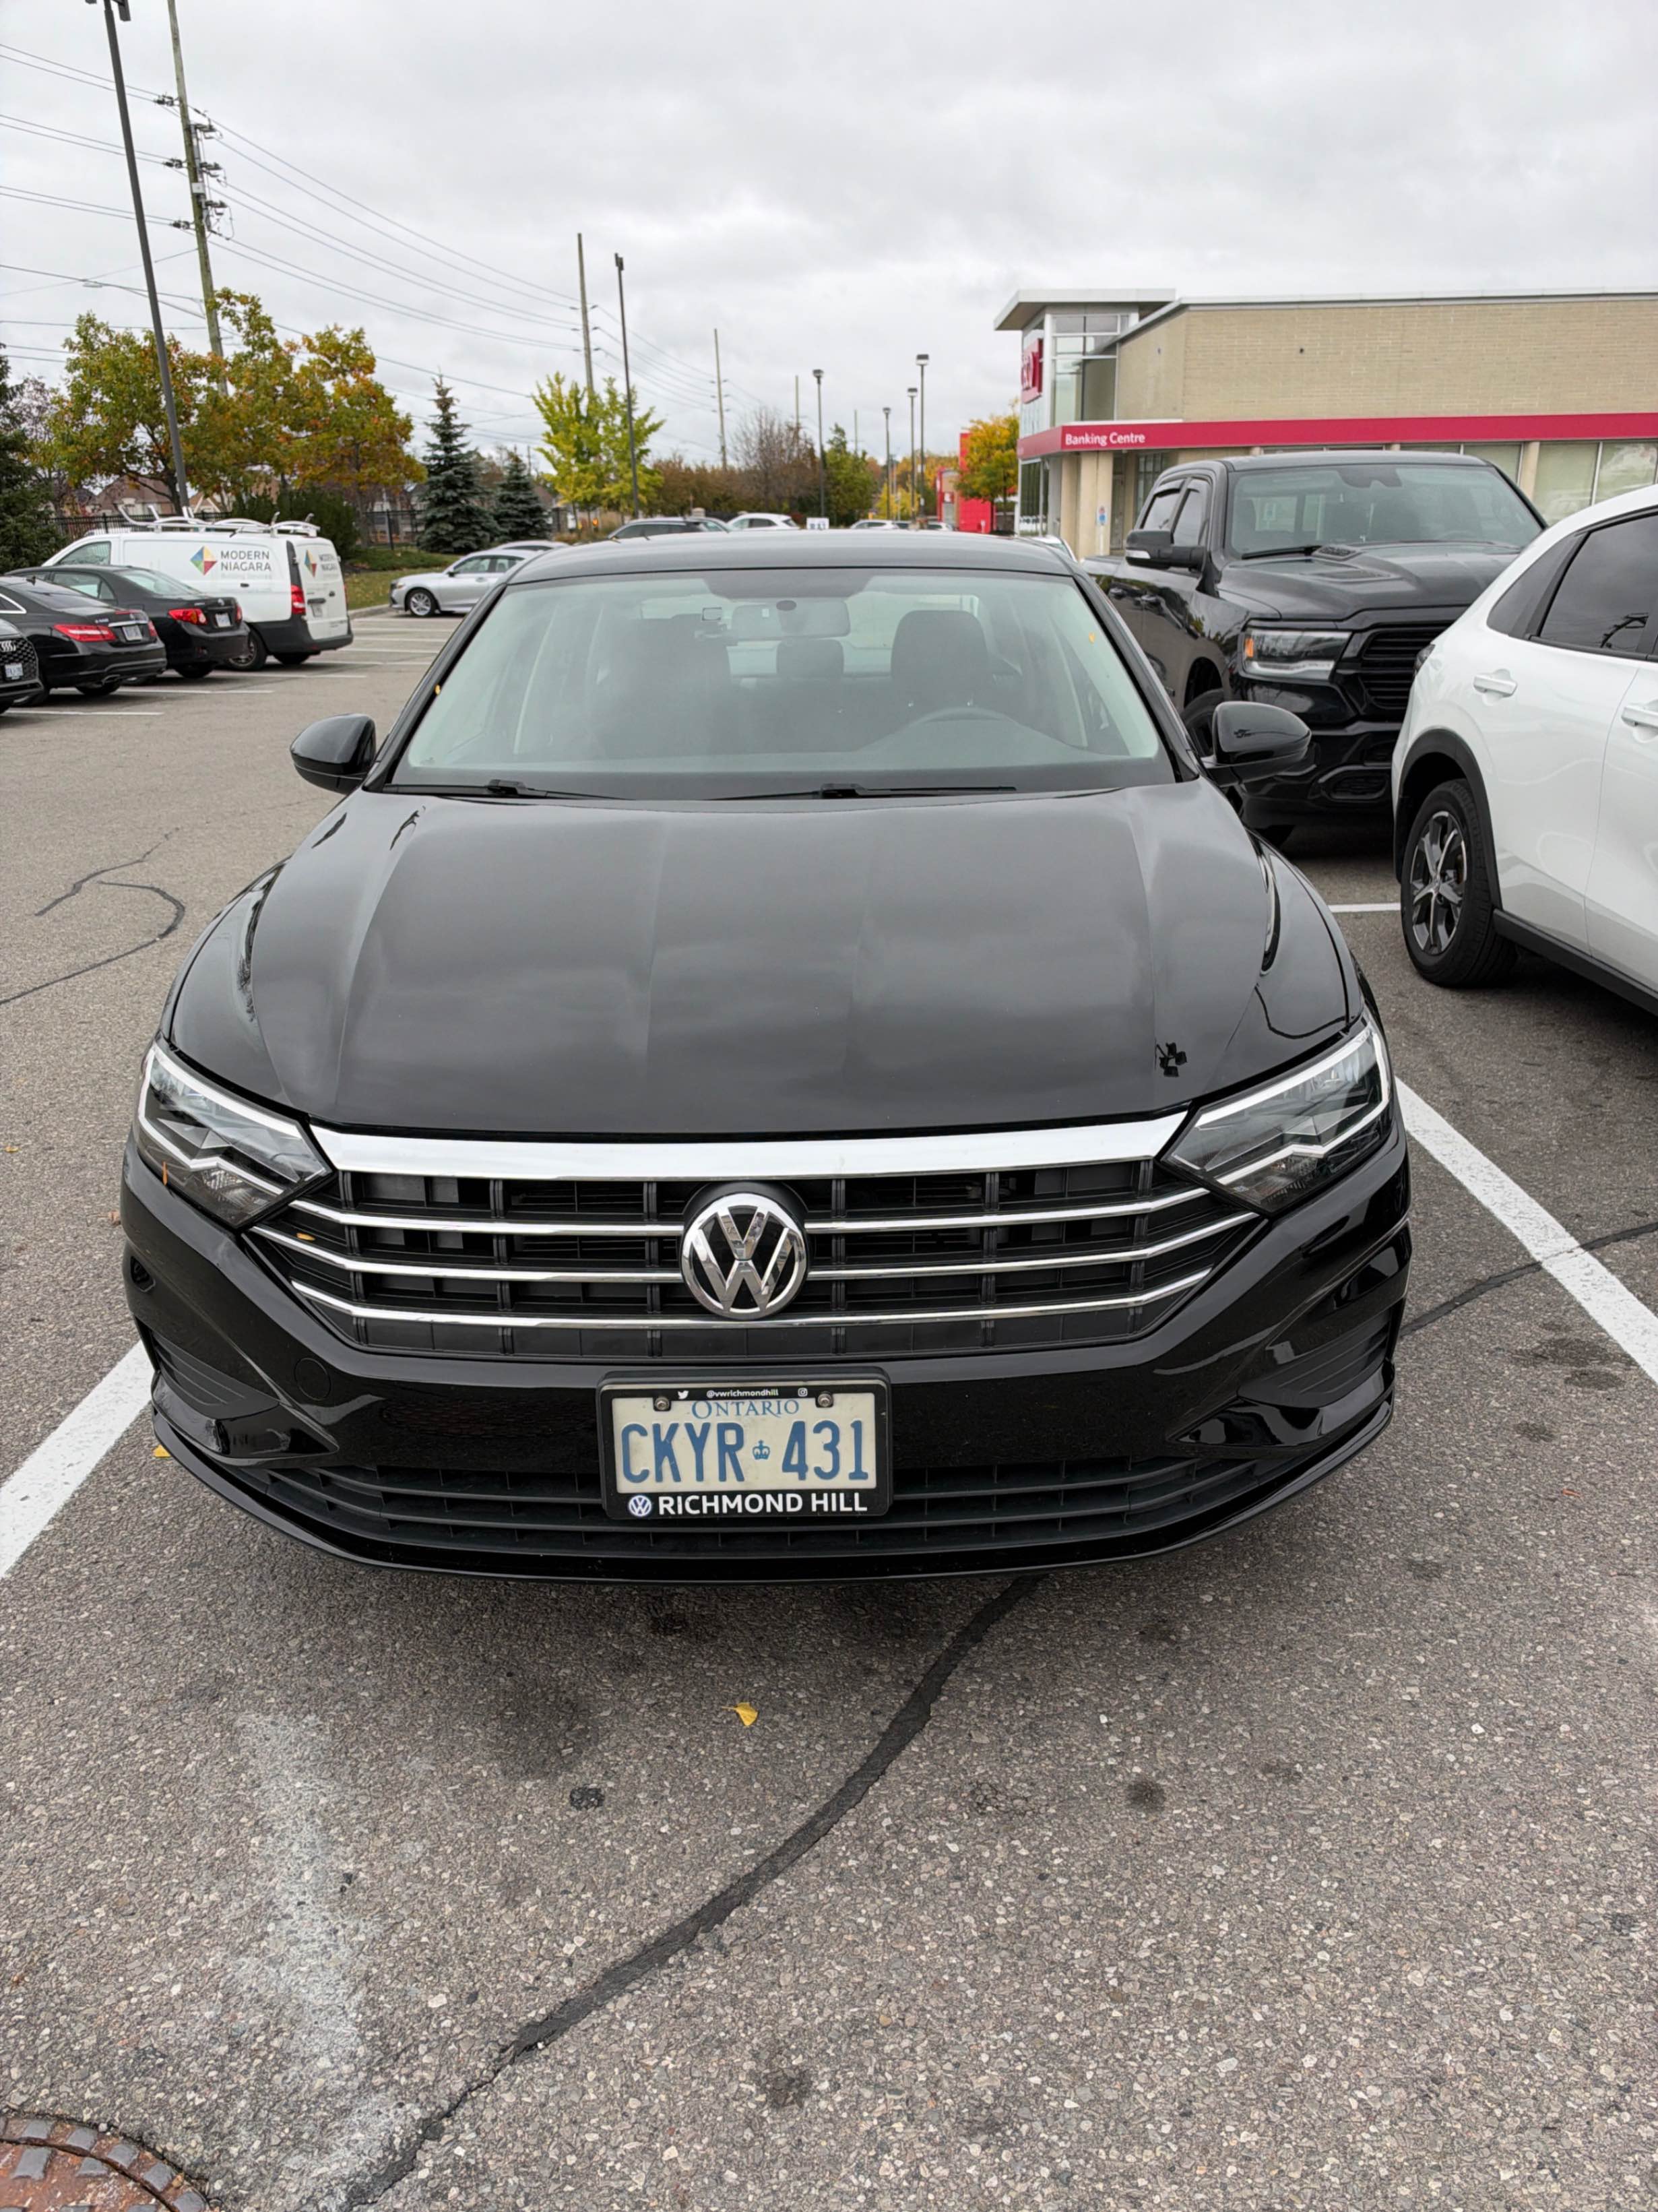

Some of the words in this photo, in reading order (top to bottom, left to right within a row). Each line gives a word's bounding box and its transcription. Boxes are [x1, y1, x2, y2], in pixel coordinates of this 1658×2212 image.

[1065, 431, 1108, 447] Banking
[1109, 431, 1146, 444] Centre
[220, 550, 270, 560] MODERN
[220, 561, 272, 571] NIAGARA
[706, 1388, 779, 1399] @vwrichmondhill
[620, 1422, 745, 1484] CKYR
[782, 1420, 869, 1482] 431
[658, 1492, 804, 1515] RICHMOND
[810, 1492, 868, 1513] HILL
